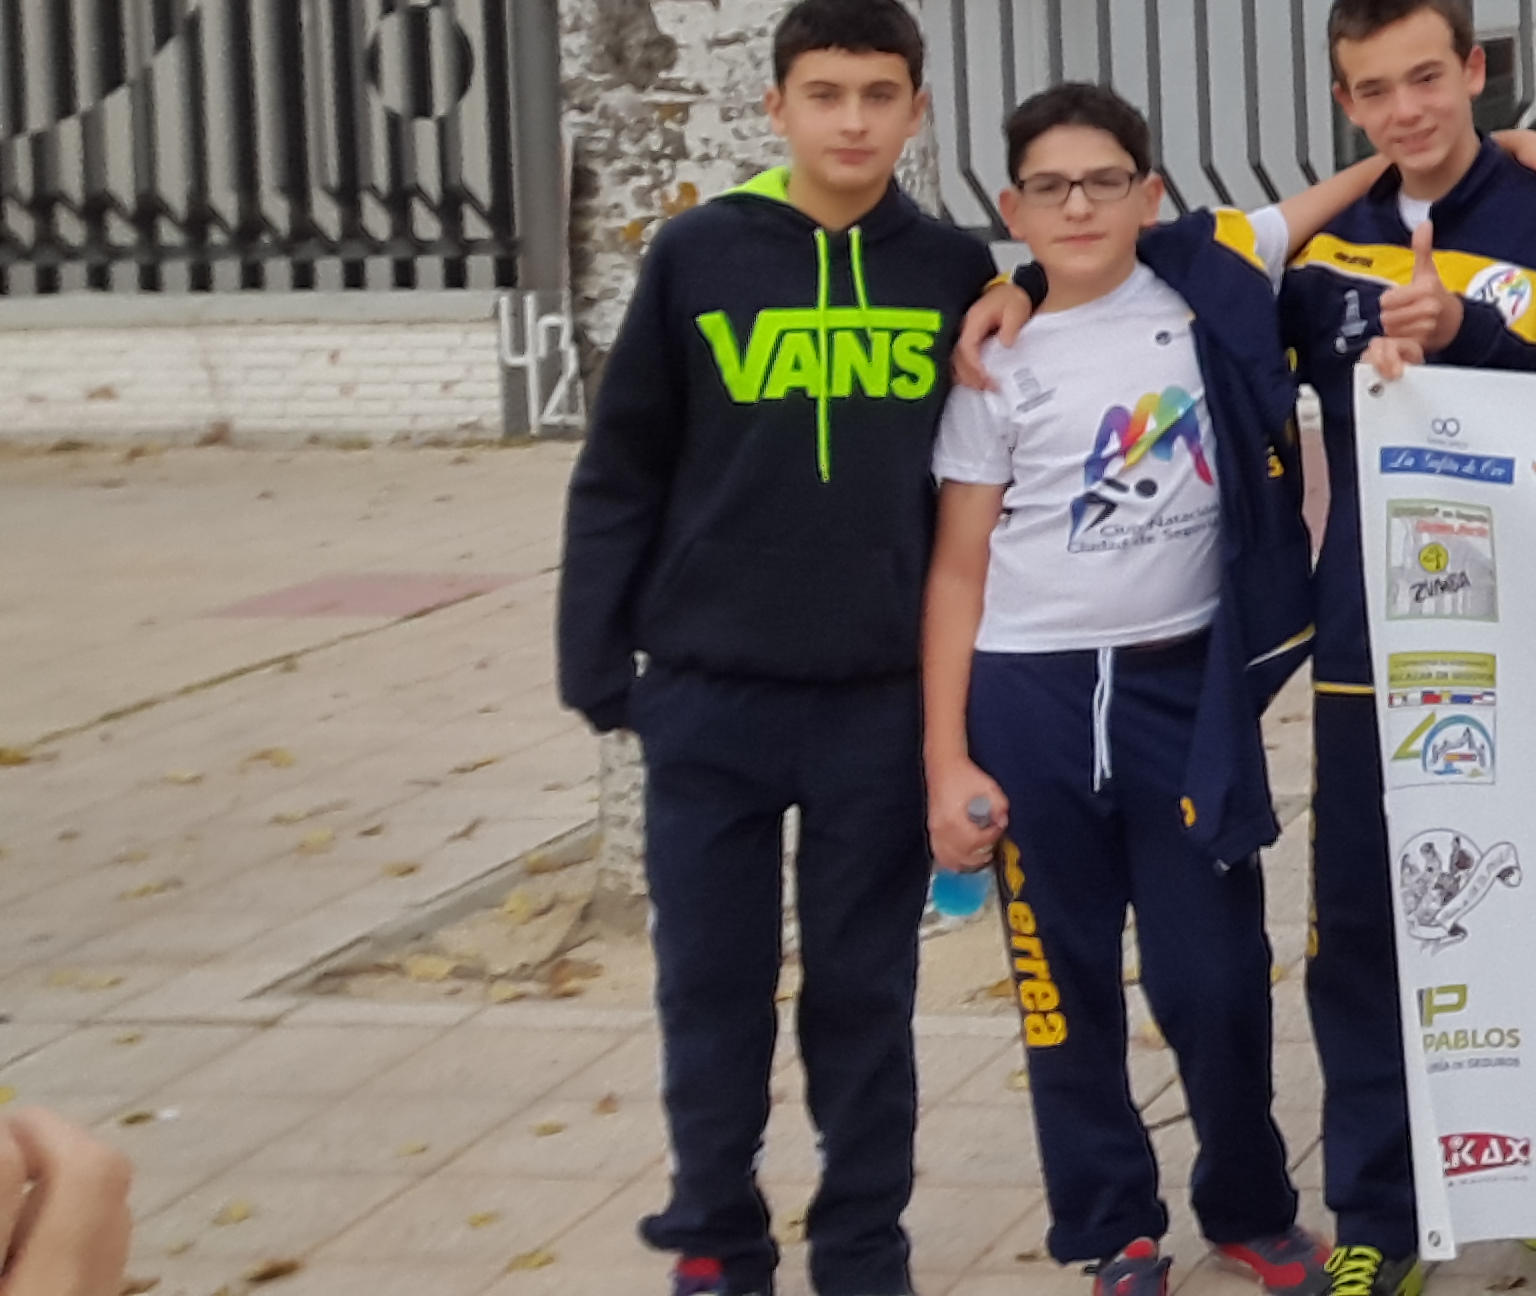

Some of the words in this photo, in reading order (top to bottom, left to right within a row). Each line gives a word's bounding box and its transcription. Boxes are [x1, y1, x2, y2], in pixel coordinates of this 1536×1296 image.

[695, 306, 942, 404] VANS
[1007, 900, 1069, 1048] errea
[1422, 1027, 1521, 1053] PABLOS
